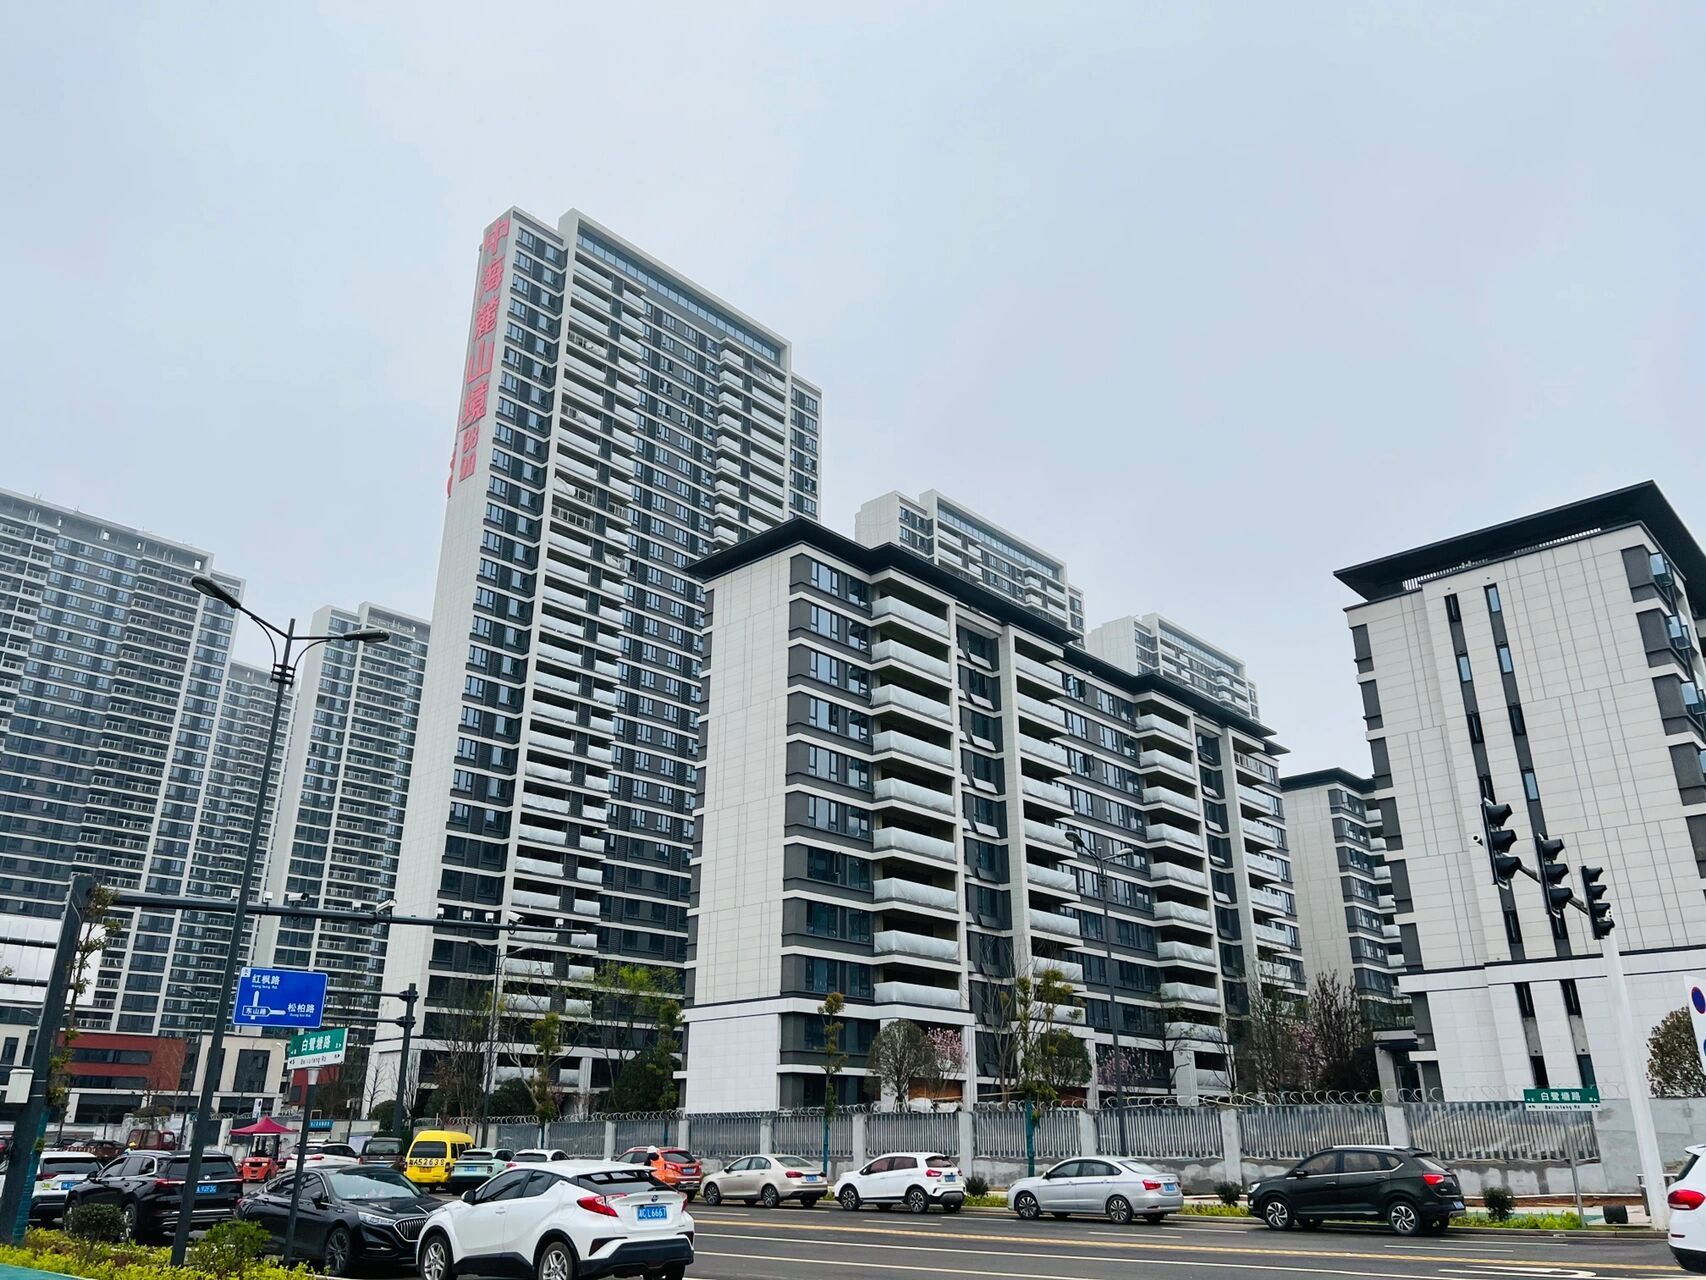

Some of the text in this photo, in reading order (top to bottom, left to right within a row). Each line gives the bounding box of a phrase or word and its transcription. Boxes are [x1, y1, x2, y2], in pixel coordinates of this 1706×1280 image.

[251, 973, 280, 985] 红枫路
[245, 1007, 267, 1015] 东山路
[287, 1002, 315, 1014] 松柏路
[301, 1034, 331, 1052] 白鹭塘路
[1540, 1091, 1581, 1101] 白鹭塘路
